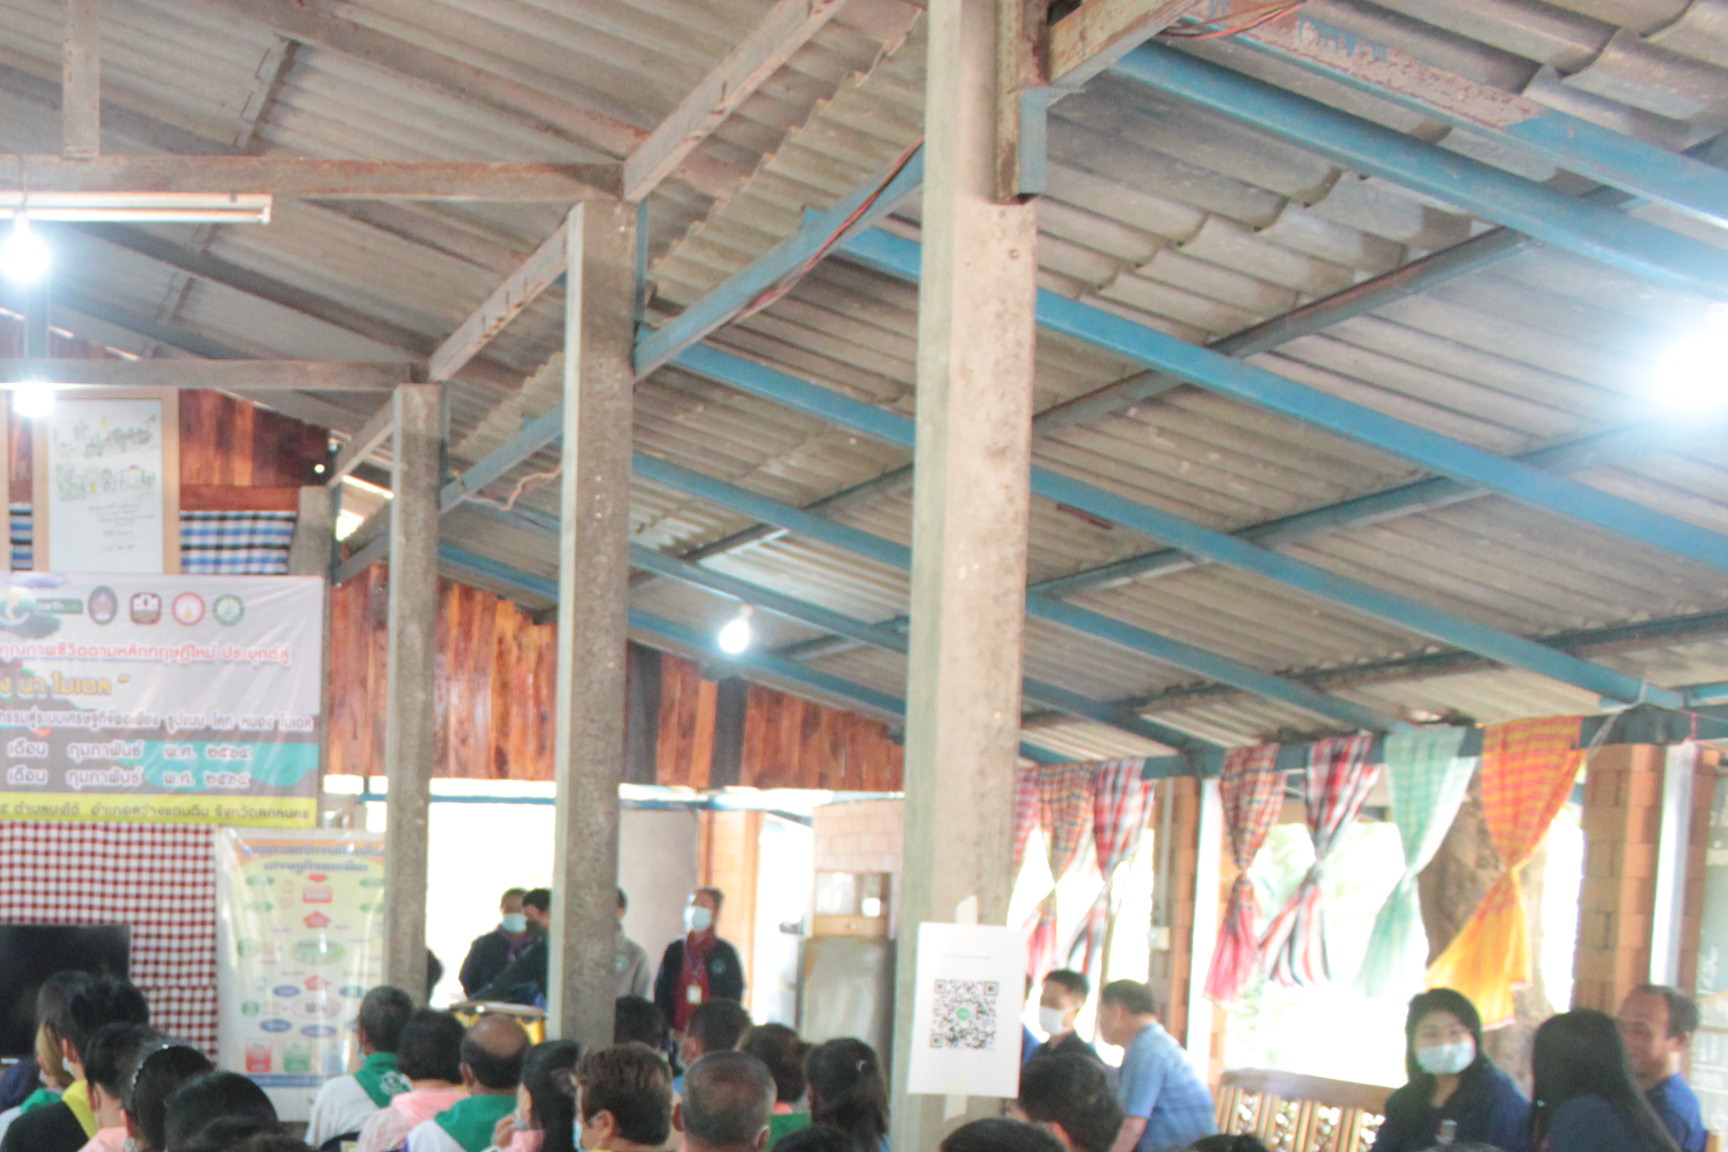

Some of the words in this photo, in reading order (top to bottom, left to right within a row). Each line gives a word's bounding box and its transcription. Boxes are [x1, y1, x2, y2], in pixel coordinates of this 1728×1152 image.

[20, 677, 46, 694] นา
[52, 671, 111, 694] โมเดล
[10, 740, 46, 756] เดือน
[69, 741, 142, 760] กุมภาพันธ์
[10, 767, 46, 784] เดือน
[68, 767, 141, 787] กุมภาพันธ์
